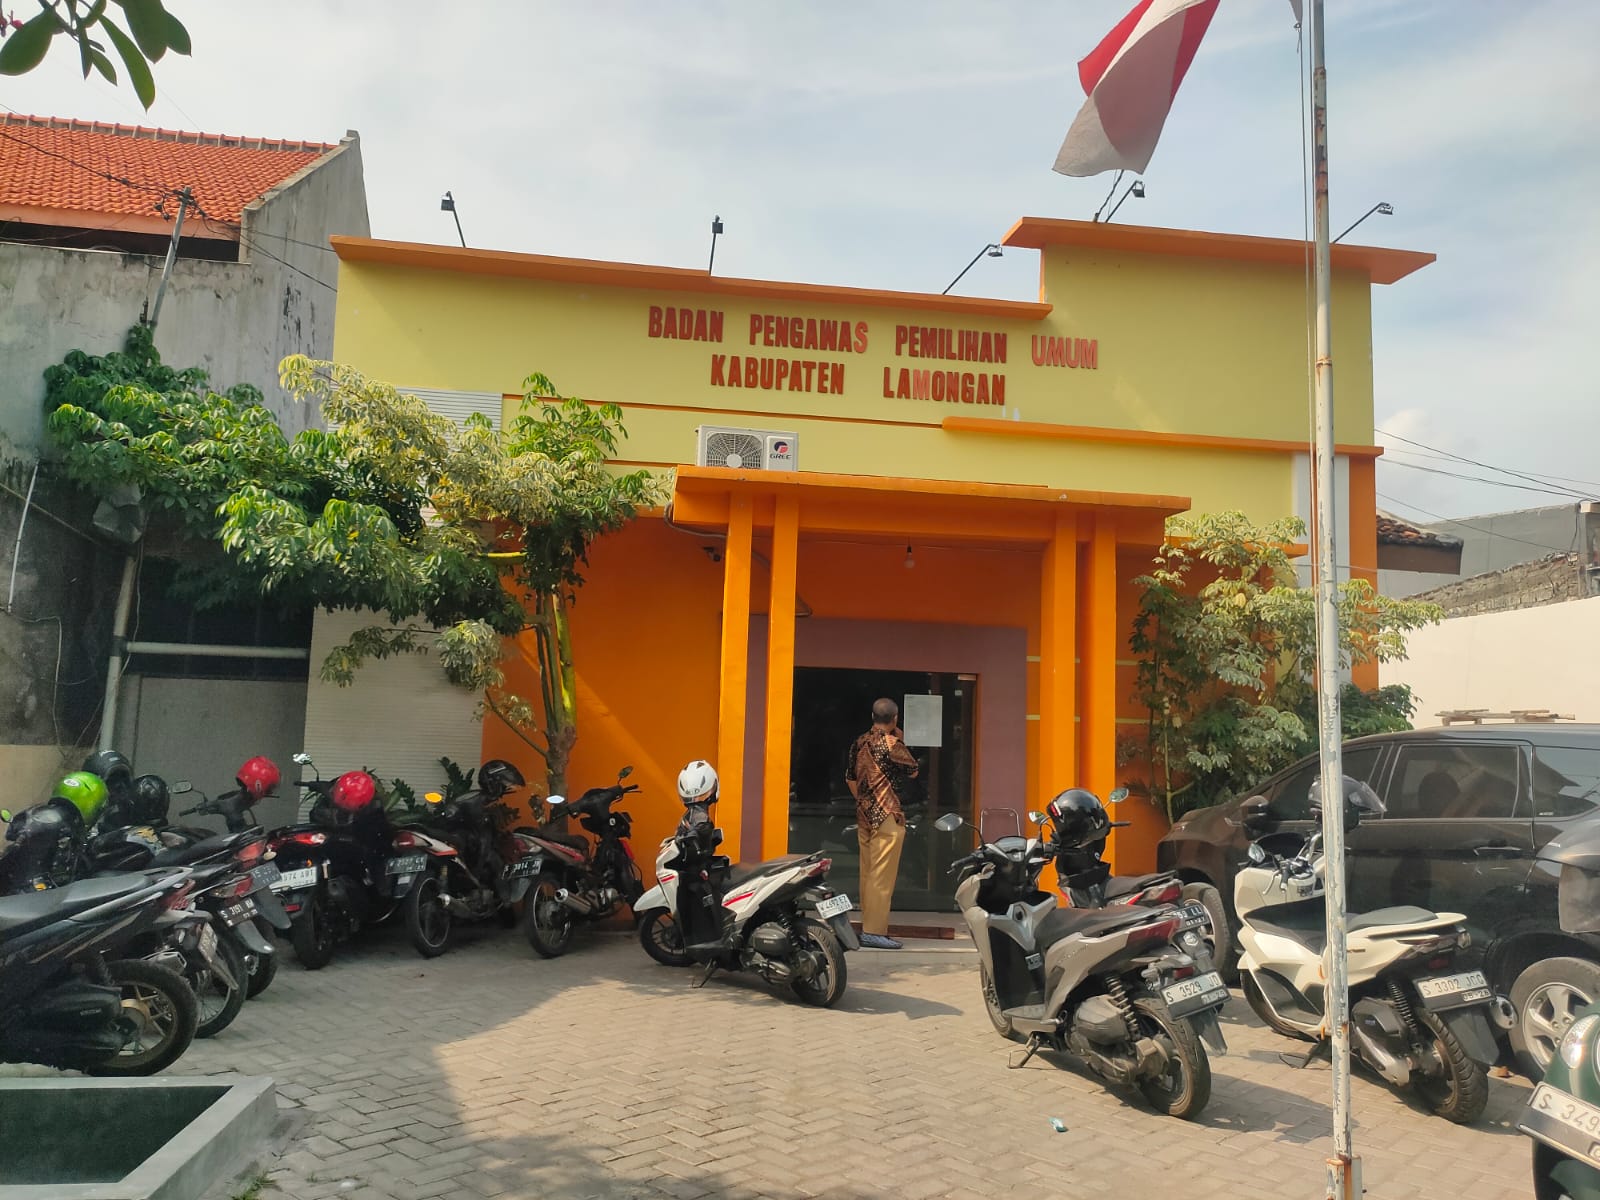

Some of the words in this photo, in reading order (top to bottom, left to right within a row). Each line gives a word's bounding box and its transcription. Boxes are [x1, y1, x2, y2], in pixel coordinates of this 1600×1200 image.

[648, 306, 724, 342] BADAN
[749, 313, 869, 354] PENGAWAS
[895, 325, 1008, 364] PEMILIHAN
[1031, 335, 1099, 369] UMUM
[710, 354, 845, 395] KABUPATEN
[883, 366, 1006, 406] LAMONGAN
[220, 910, 228, 919] S
[1165, 991, 1174, 1003] S
[1179, 981, 1201, 998] 3529
[1422, 985, 1432, 996] S
[1434, 978, 1460, 993] 3302
[1539, 1093, 1553, 1110] S
[1561, 1104, 1600, 1137] 349
